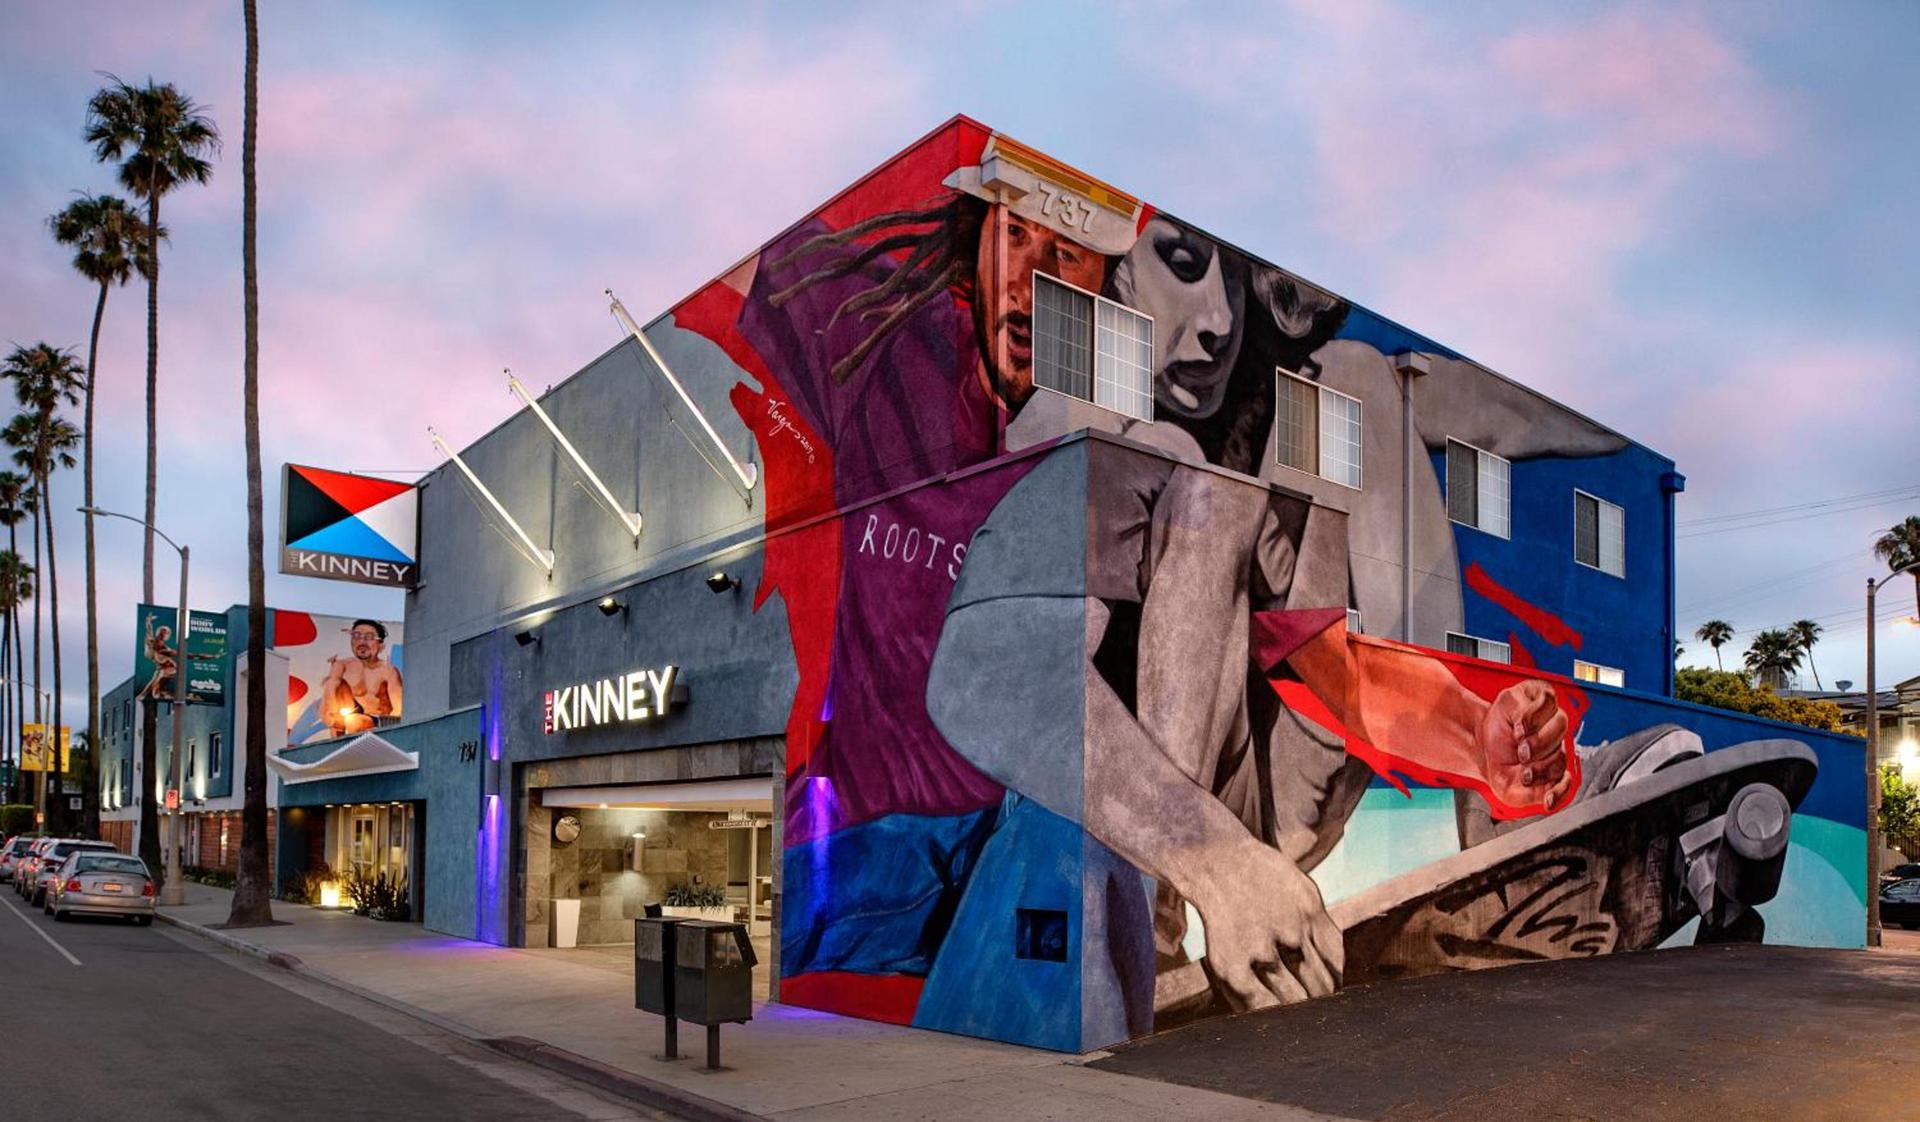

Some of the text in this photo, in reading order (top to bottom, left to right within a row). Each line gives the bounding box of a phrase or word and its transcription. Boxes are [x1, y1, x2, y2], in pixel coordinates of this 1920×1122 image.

[1038, 181, 1098, 235] 737
[299, 551, 410, 582] KINNEY
[858, 513, 968, 581] ROOTS
[553, 665, 676, 732] KINNEY
